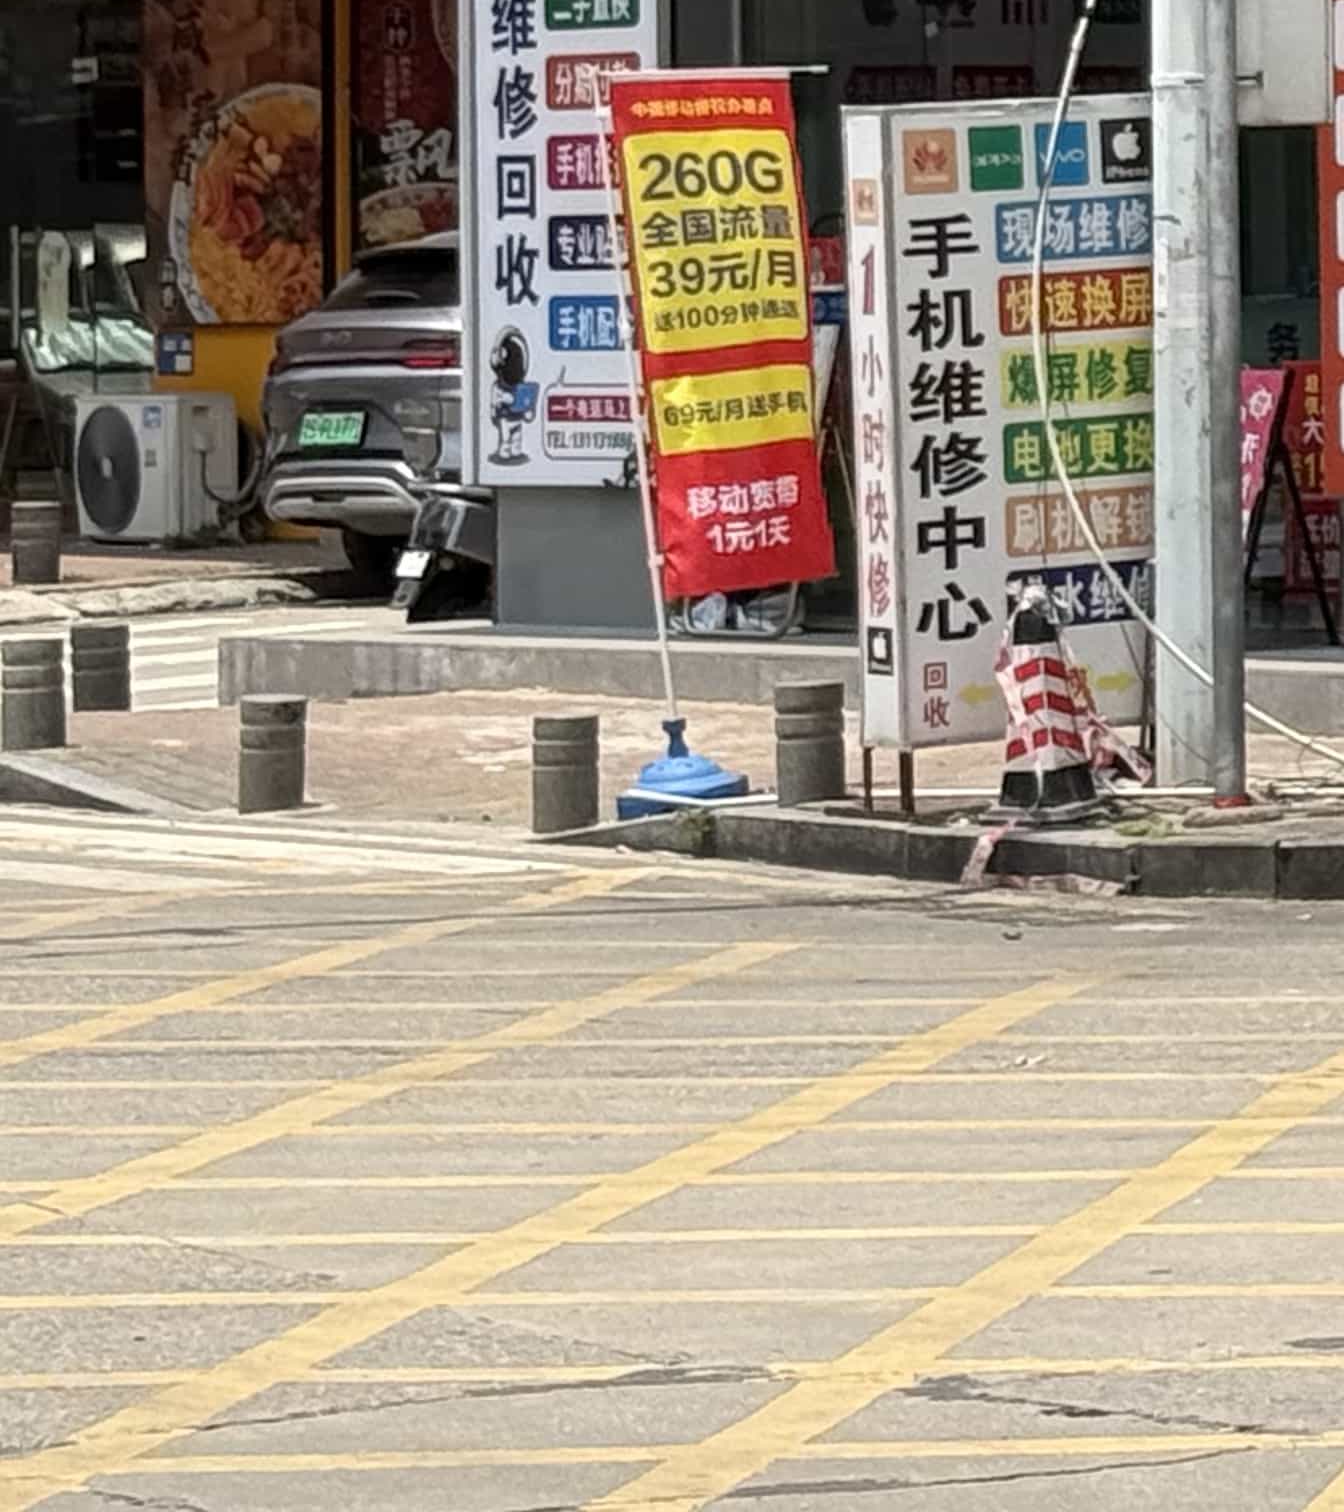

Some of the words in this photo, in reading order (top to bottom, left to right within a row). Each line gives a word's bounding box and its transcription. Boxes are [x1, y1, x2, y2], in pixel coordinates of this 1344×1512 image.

[639, 149, 784, 203] 260G
[642, 204, 795, 250] 全国流量
[1001, 200, 1151, 258] 现场维修
[648, 245, 799, 300] 39元/月
[1005, 272, 1152, 332] 快速换屏
[902, 213, 993, 642] 手机维修中心
[1012, 417, 1152, 478] 电池更换
[686, 474, 800, 521] 移动宽带
[706, 514, 793, 555] 1元1天
